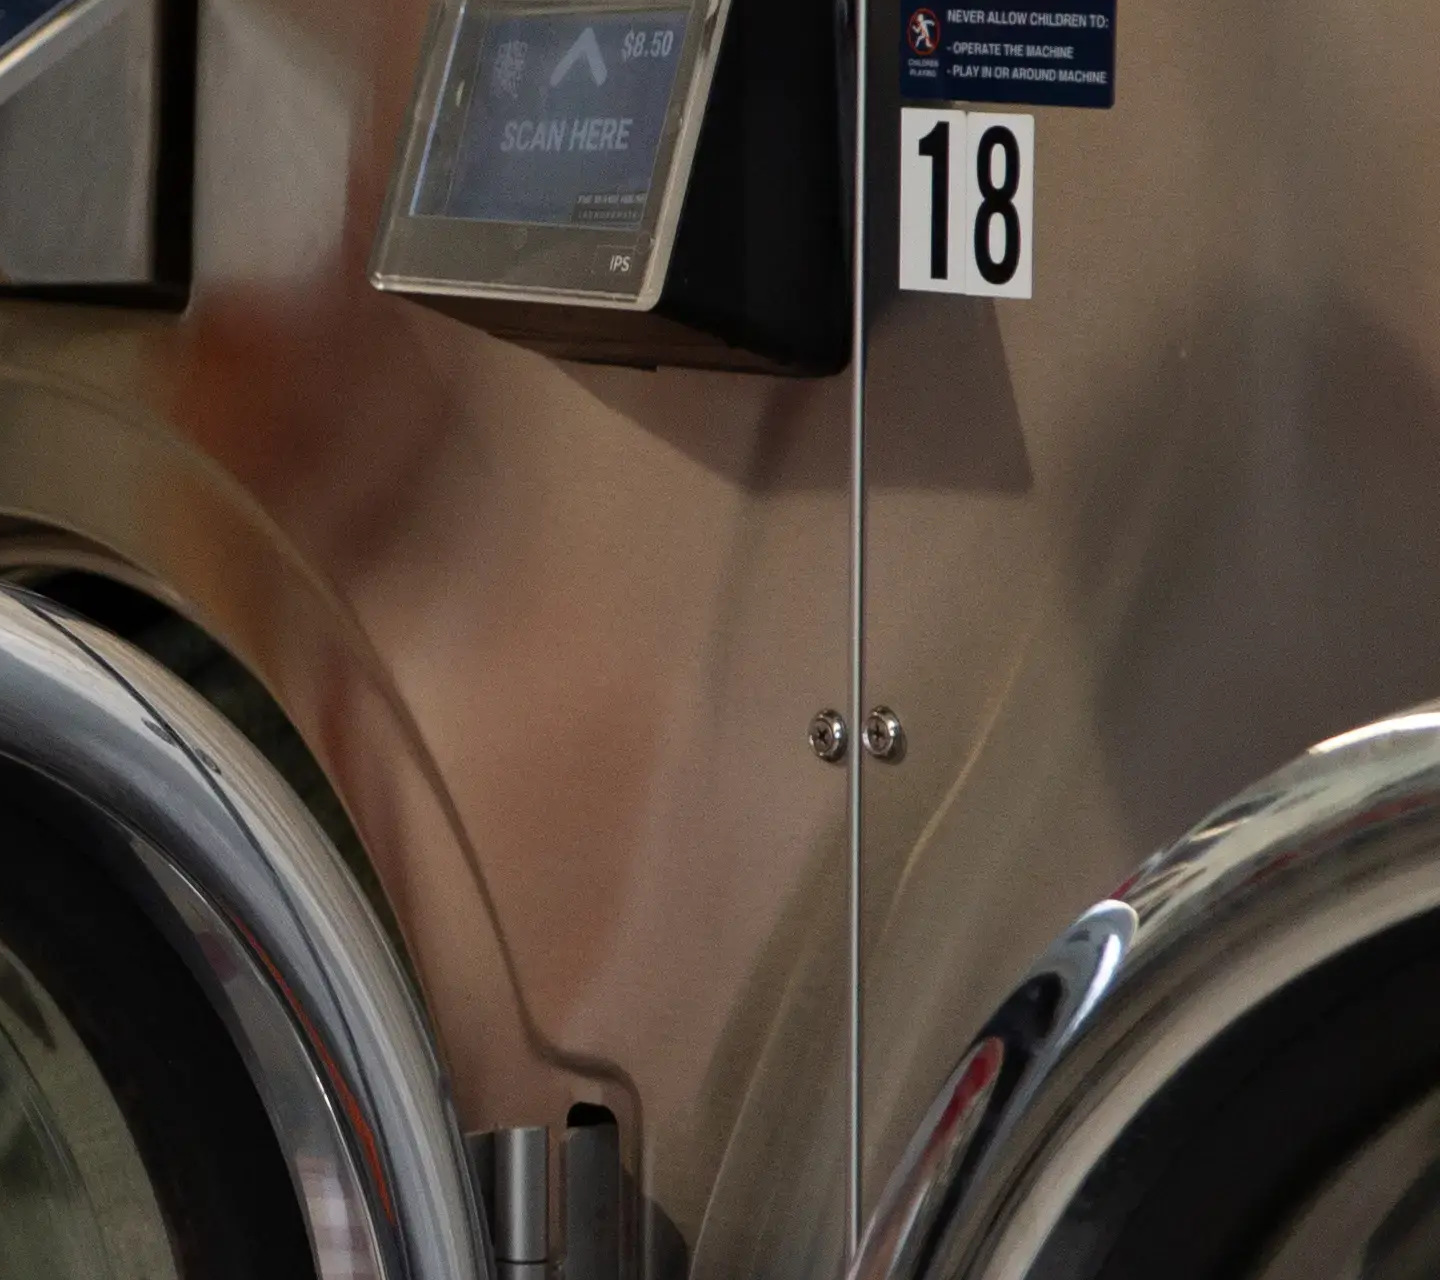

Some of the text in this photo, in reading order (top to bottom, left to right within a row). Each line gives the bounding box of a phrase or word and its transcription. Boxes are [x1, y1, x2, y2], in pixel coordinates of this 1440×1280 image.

[947, 9, 1110, 29] NEVER ALLOW CHILDREN TO:
[620, 29, 674, 62] $8.50
[953, 41, 1001, 56] OPERATE
[1003, 43, 1023, 57] THE
[1026, 45, 1074, 59] MACHINE
[953, 65, 979, 78] PLAY
[982, 66, 992, 78] IN
[995, 66, 1010, 79] OR
[1012, 67, 1056, 81] AROUND
[1059, 69, 1108, 84] MACHINE
[500, 118, 633, 152] SCAN HERE
[918, 120, 1021, 287] 18
[609, 255, 630, 272] IPS
